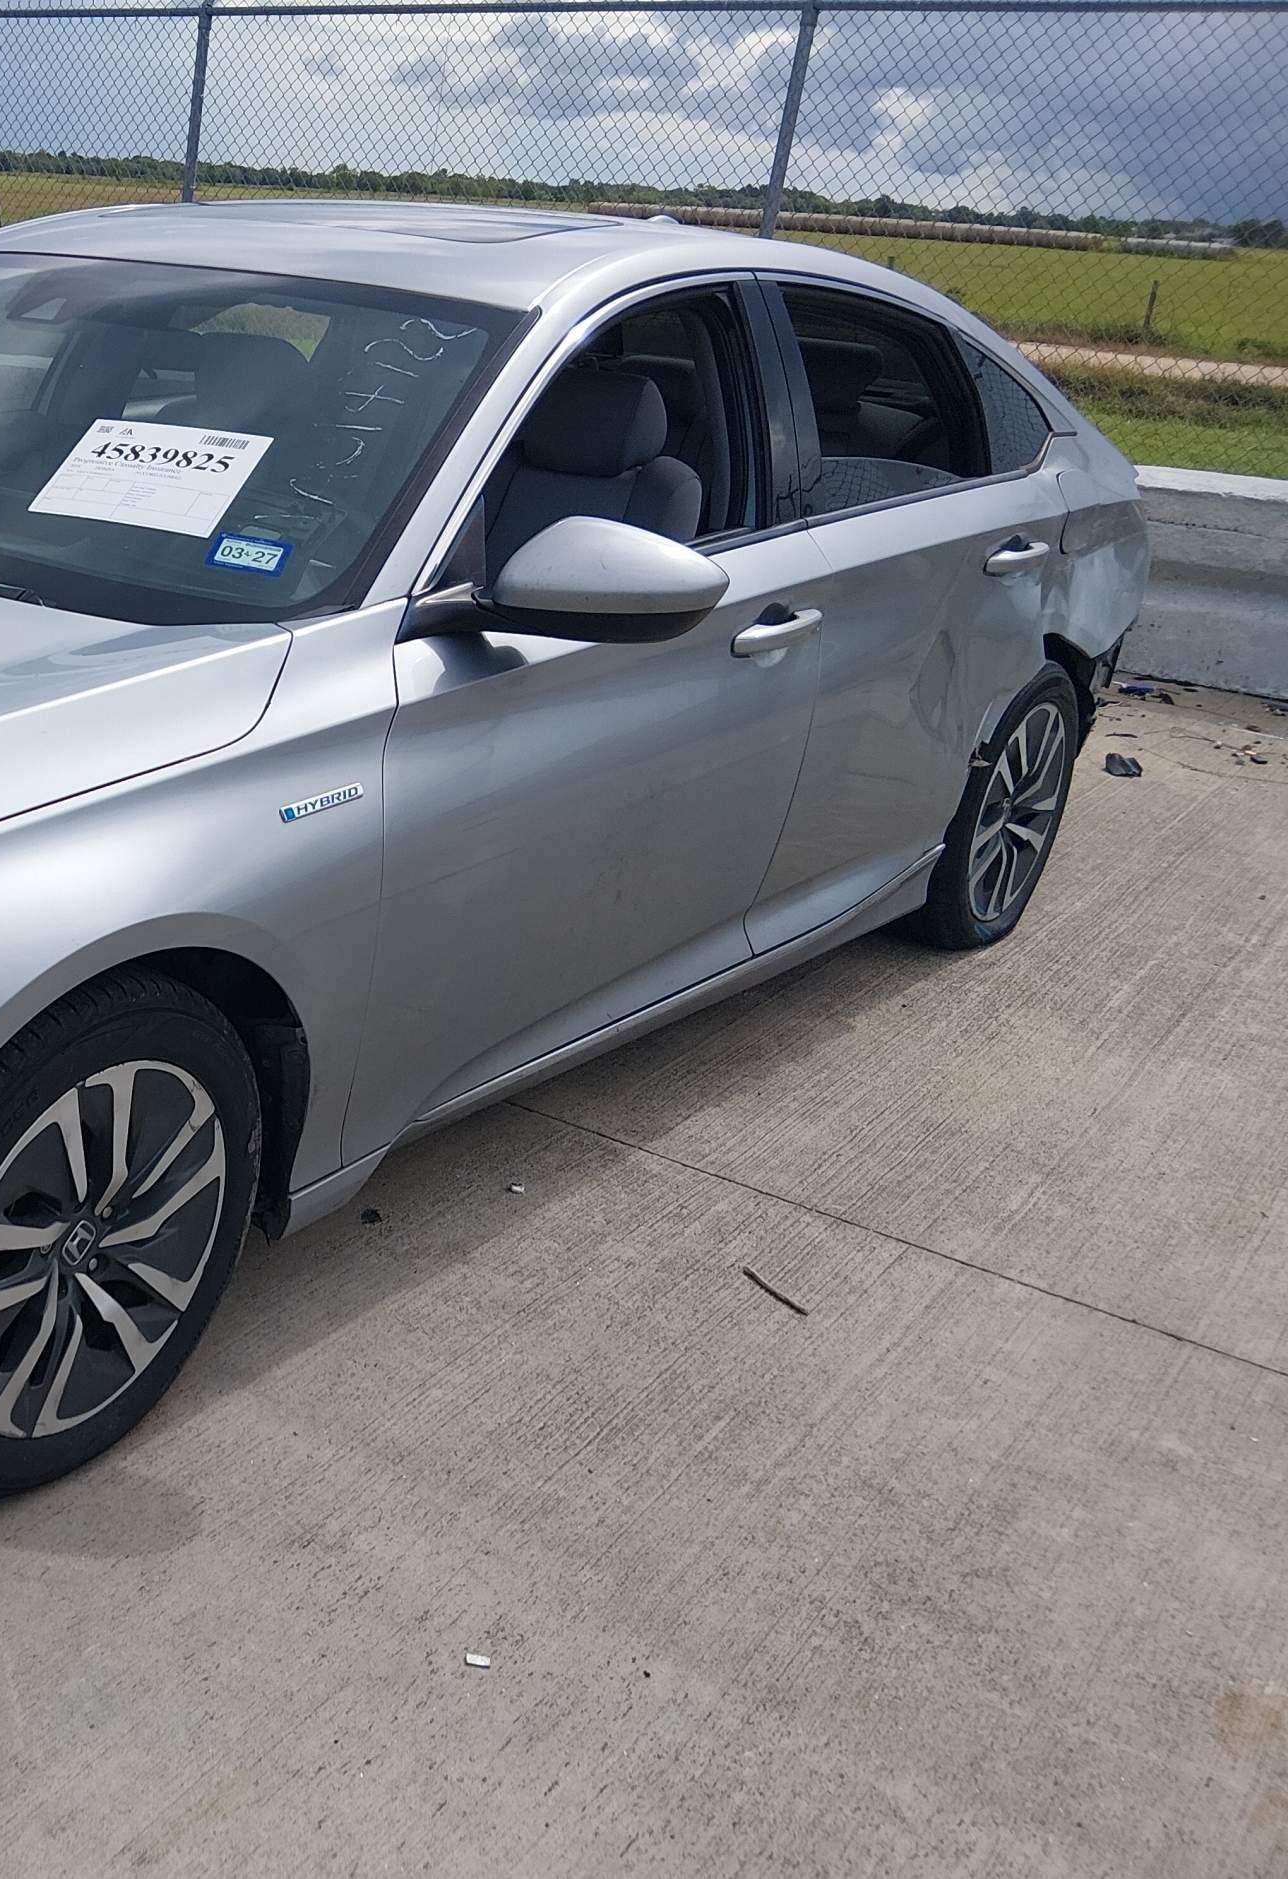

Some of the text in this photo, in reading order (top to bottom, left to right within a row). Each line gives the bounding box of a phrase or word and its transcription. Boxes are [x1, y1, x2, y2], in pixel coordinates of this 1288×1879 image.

[91, 441, 235, 473] 45839825
[220, 545, 245, 560] 03
[251, 550, 278, 565] 27
[296, 786, 359, 815] HYBRID
